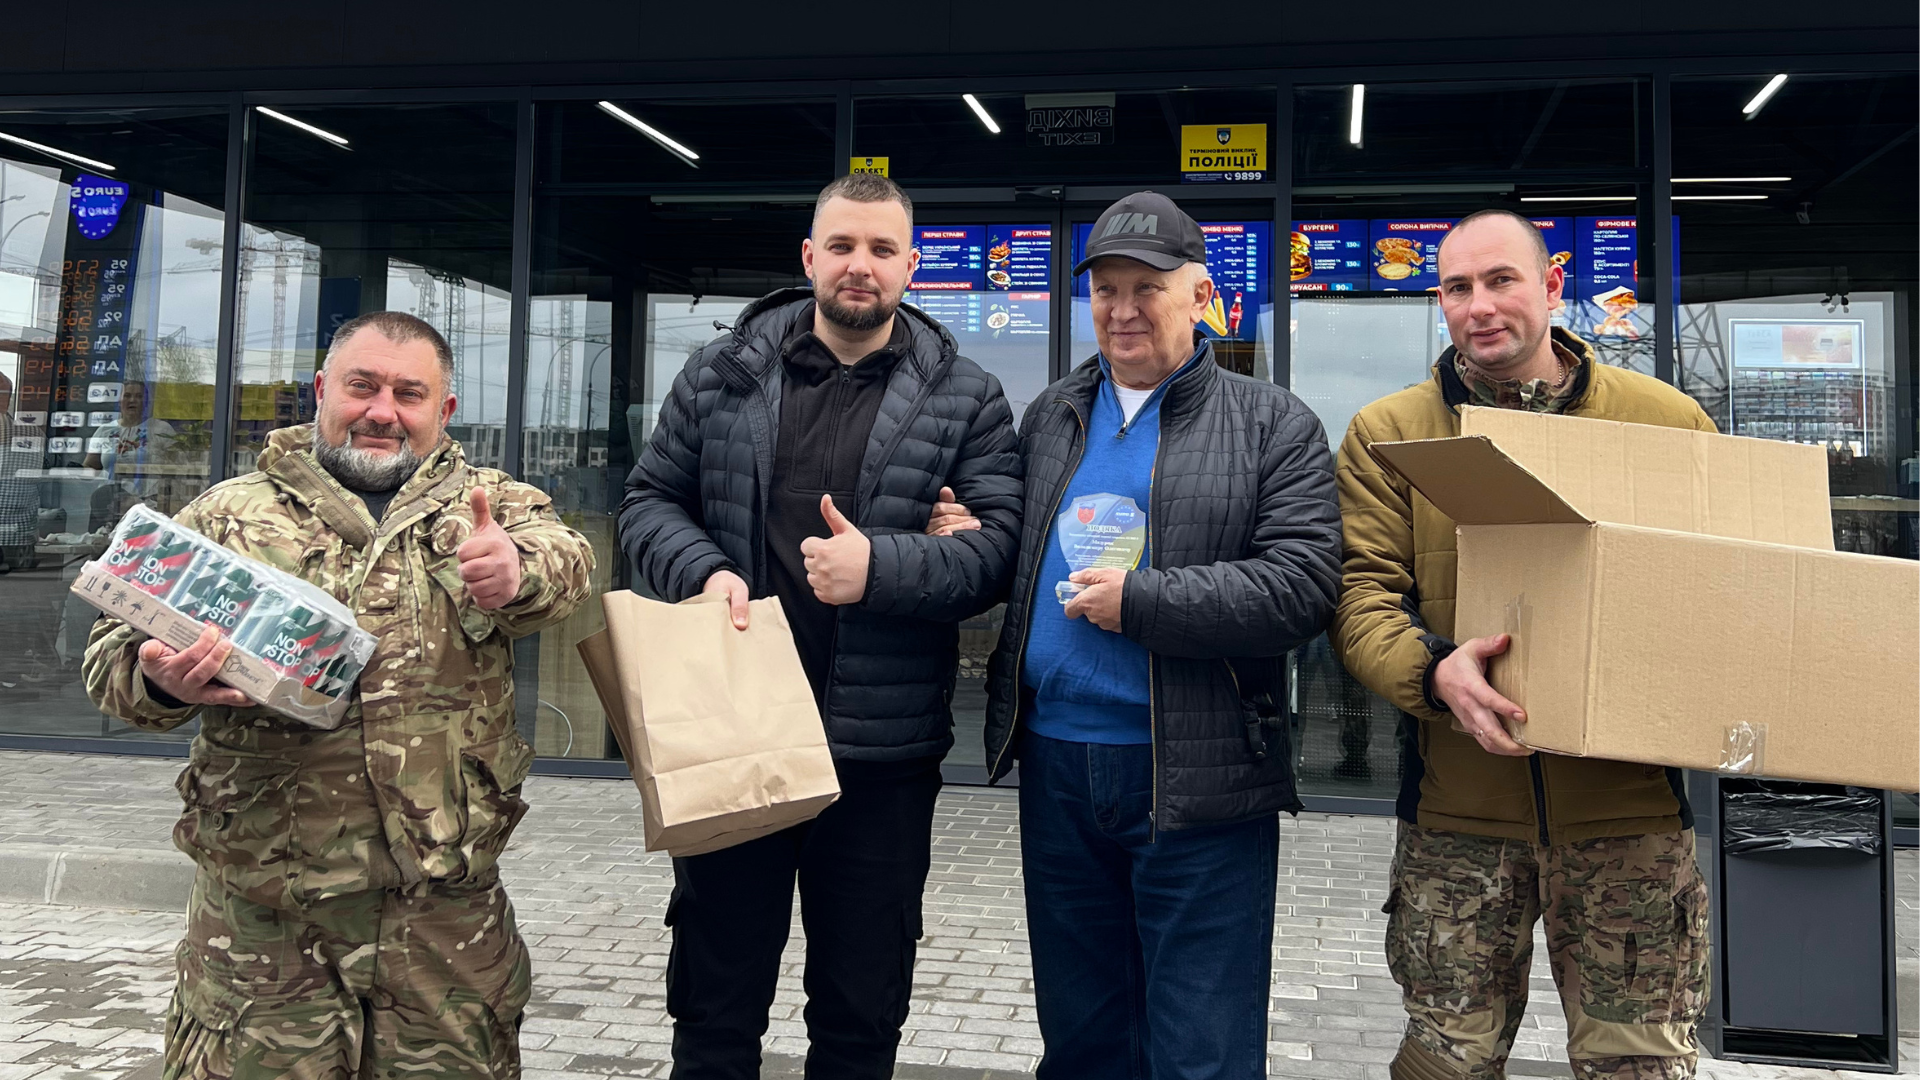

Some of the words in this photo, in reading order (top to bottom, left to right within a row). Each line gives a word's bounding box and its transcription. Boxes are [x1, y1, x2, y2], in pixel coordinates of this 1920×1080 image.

[1189, 152, 1258, 169] ПОЛІЦІЇ
[1234, 171, 1262, 181] 9899
[274, 631, 307, 657] NON
[266, 644, 302, 669] STOP
